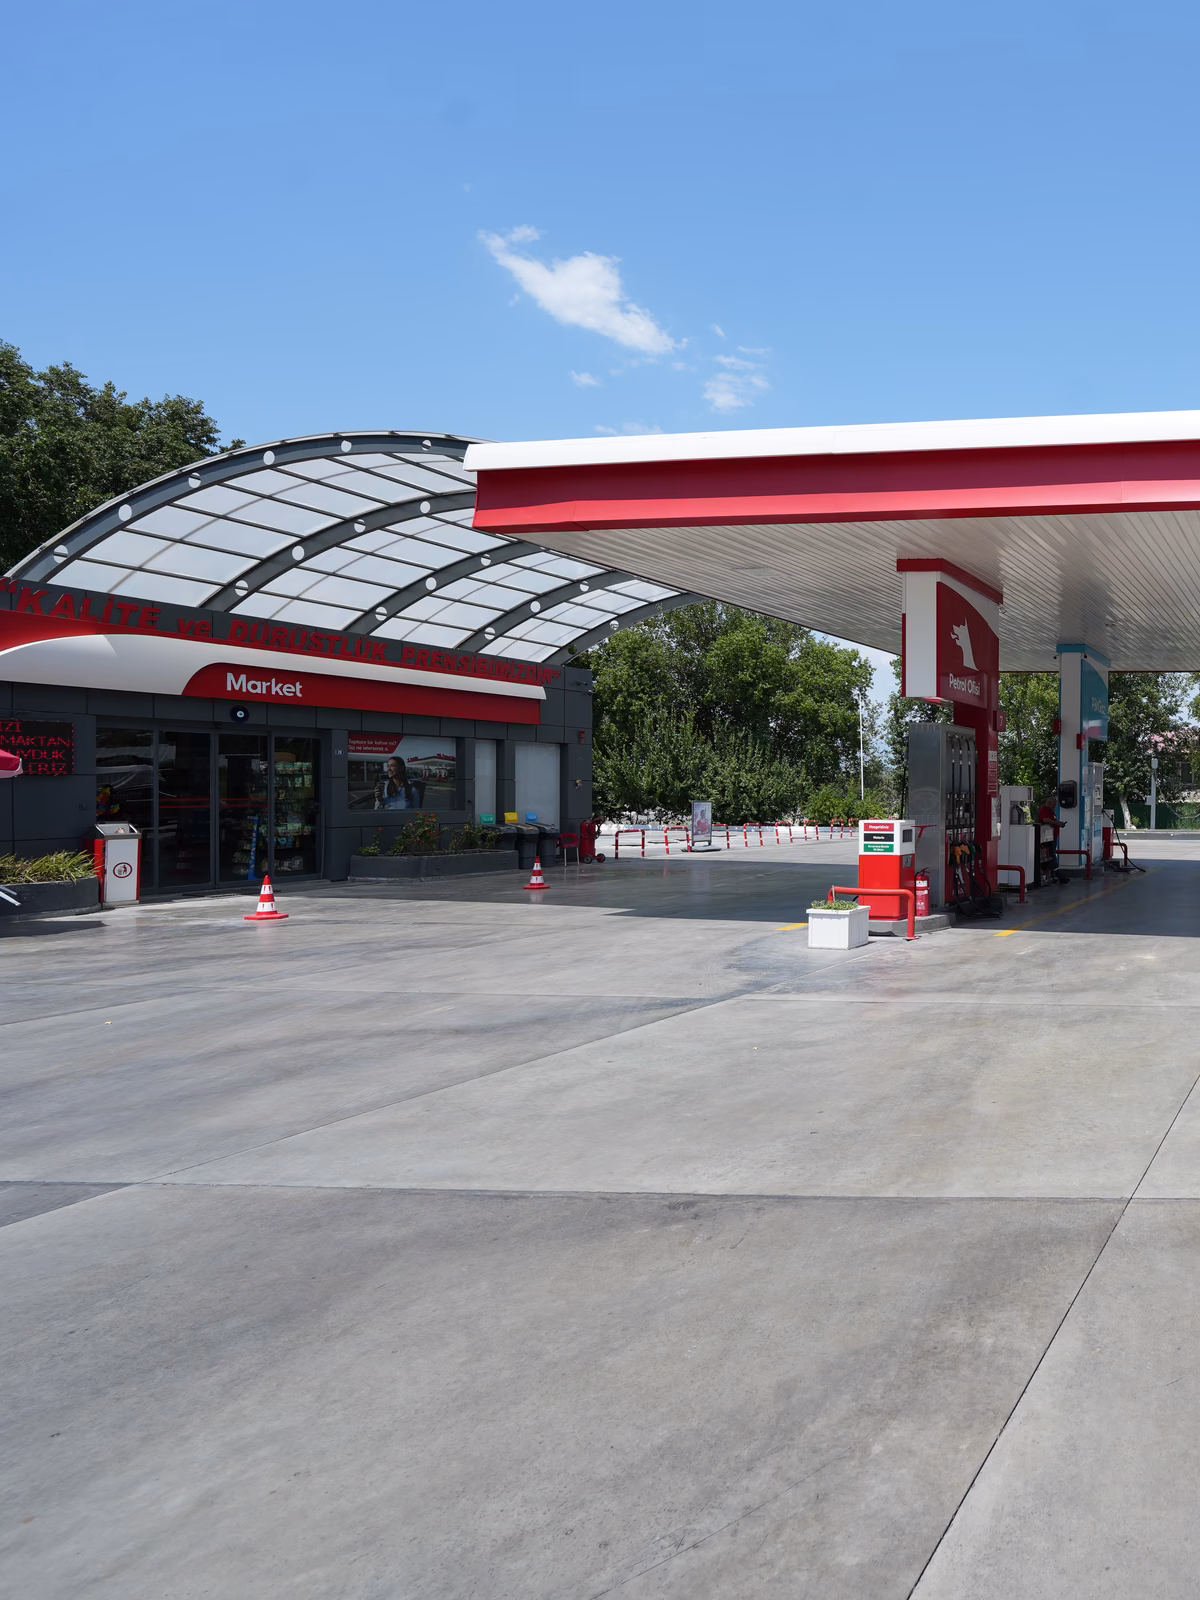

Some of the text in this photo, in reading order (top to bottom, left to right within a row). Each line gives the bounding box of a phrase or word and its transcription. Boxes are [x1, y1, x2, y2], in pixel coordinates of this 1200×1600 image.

[177, 617, 212, 637] ve
[226, 672, 303, 698] Market
[949, 673, 981, 697] Petrol Ofisi
